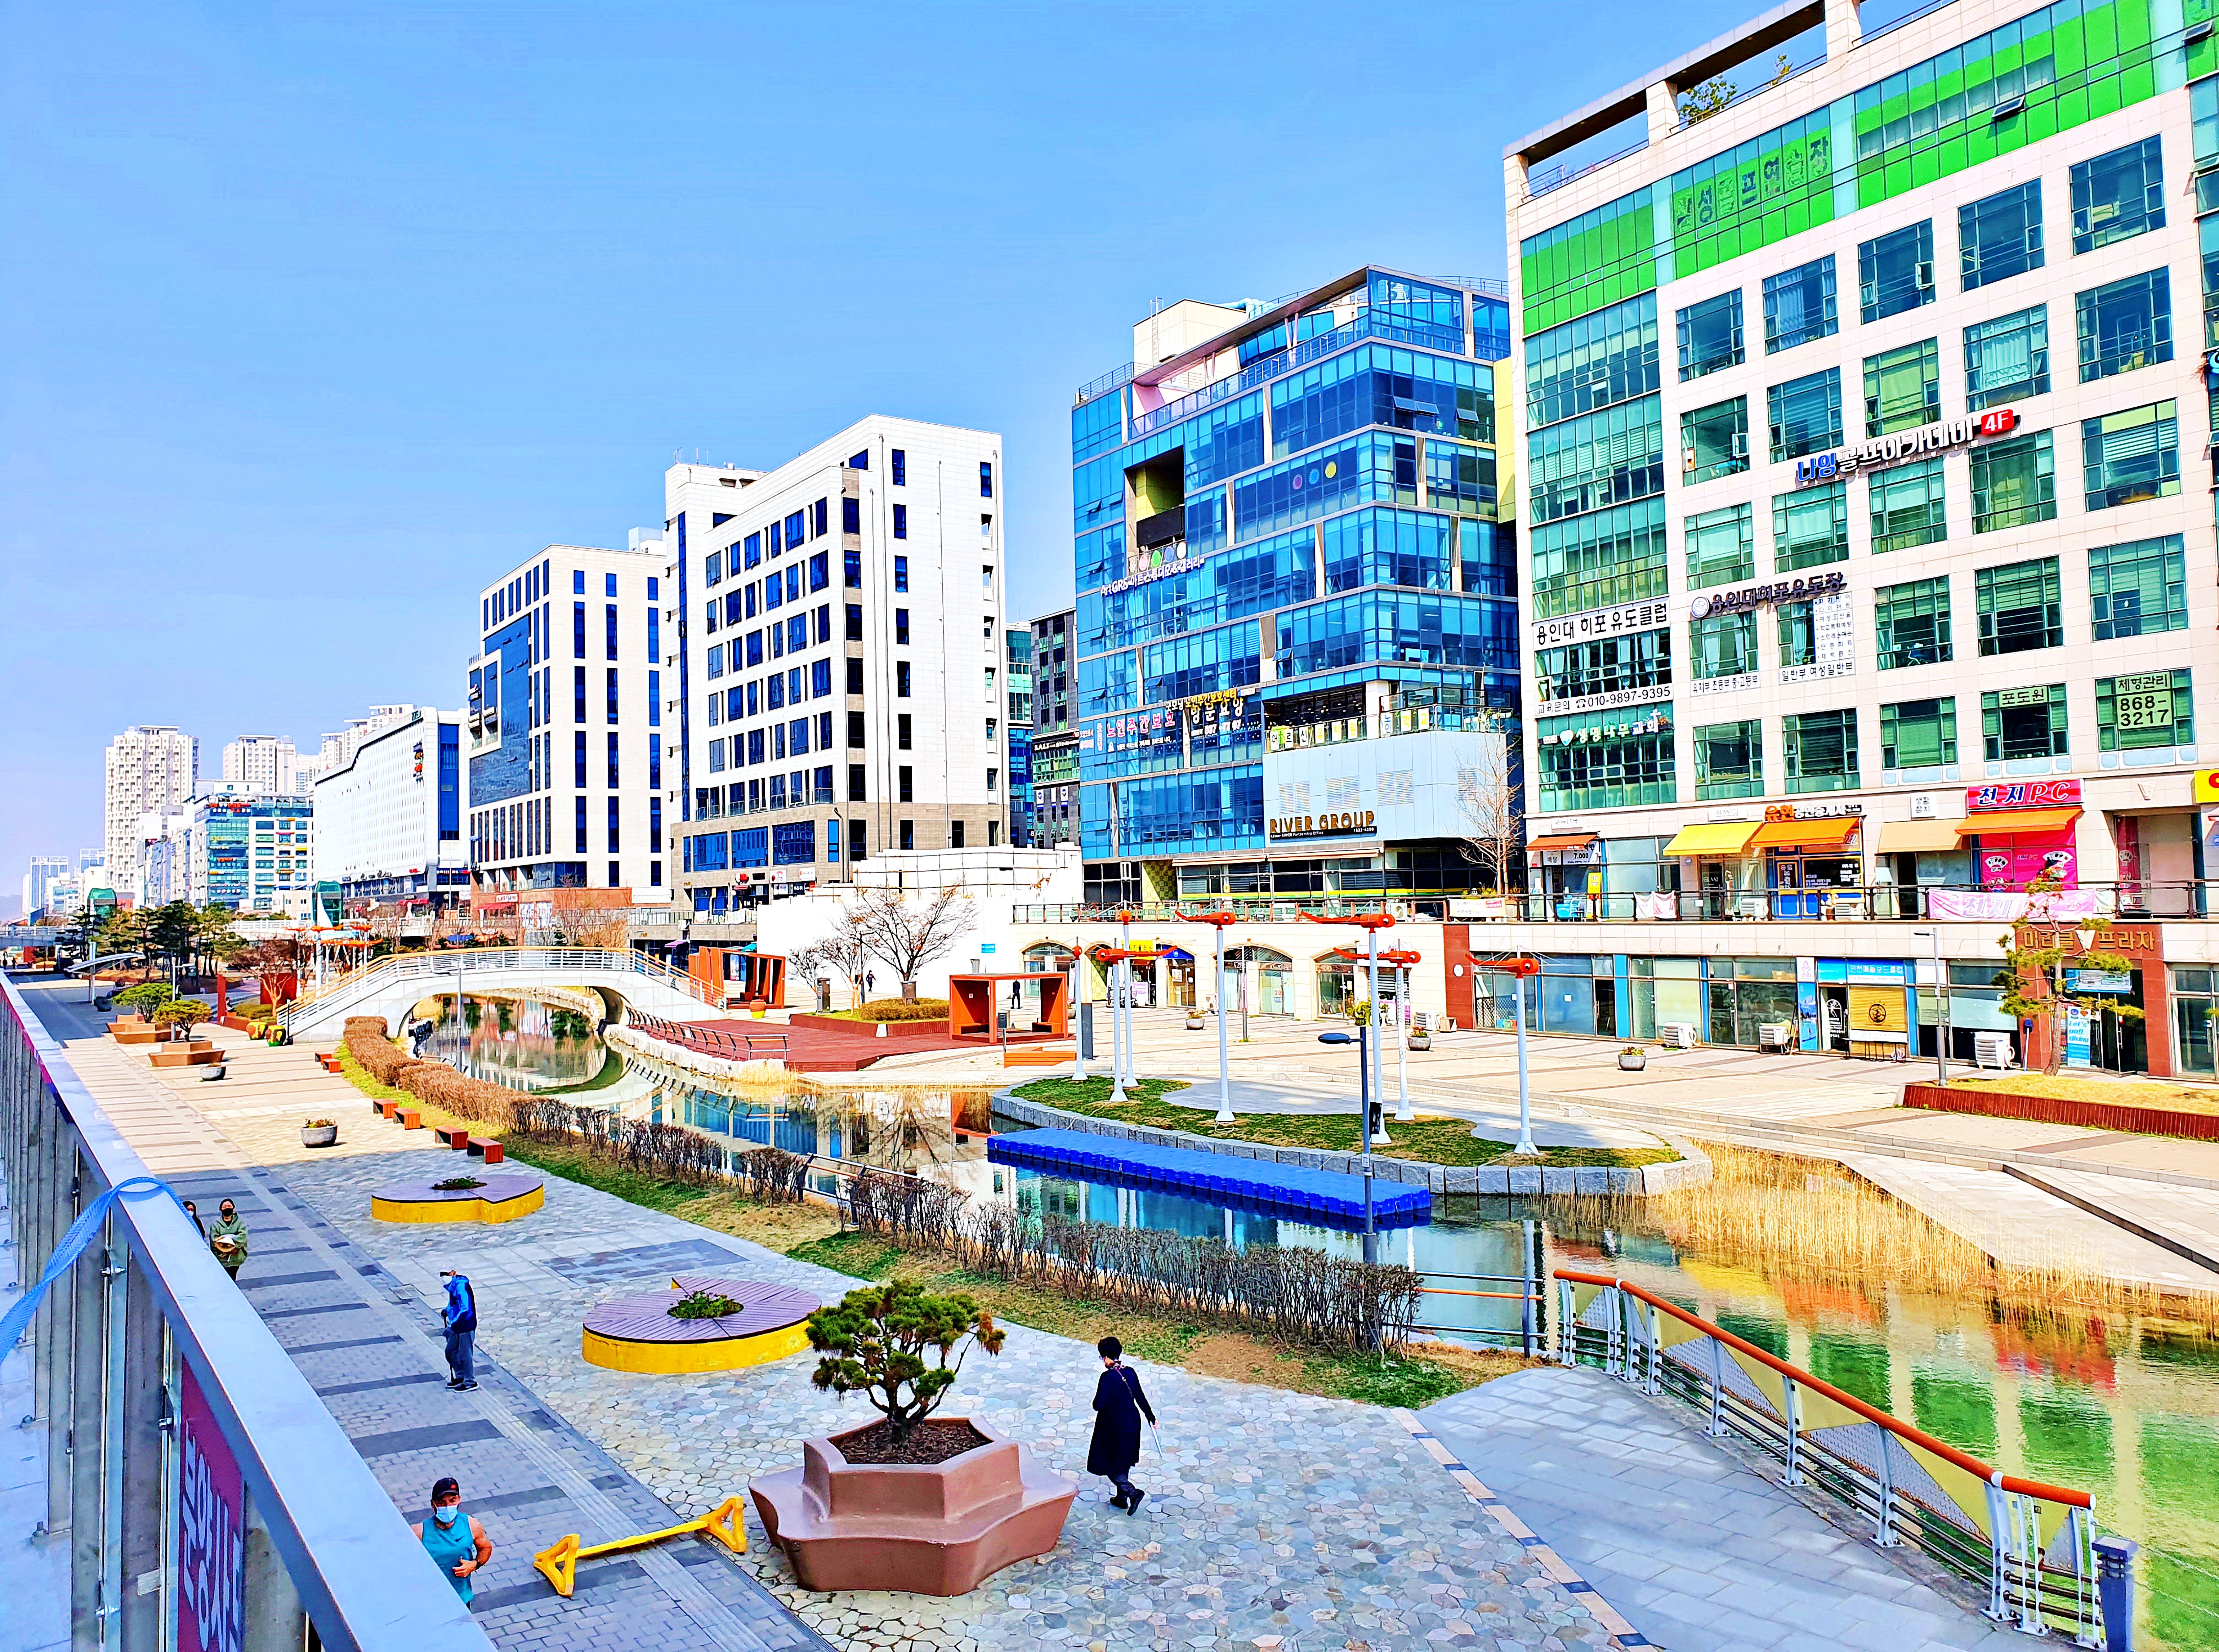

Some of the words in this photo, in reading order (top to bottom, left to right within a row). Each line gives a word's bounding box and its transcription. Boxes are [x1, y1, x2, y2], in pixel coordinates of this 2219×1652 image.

[1984, 412, 2009, 432] 4F
[1537, 621, 1574, 645] 용인대
[2118, 674, 2168, 691] 체형관리
[1588, 686, 1671, 707] 010-9897-9395
[2001, 688, 2044, 705] 포도원
[2120, 695, 2167, 712] 868-
[1106, 711, 1175, 738] 노인주간보호
[2120, 709, 2169, 727] 3217
[1270, 816, 1313, 833] RIVER
[1319, 811, 1374, 830] GROUP
[2099, 930, 2155, 951] 프라자
